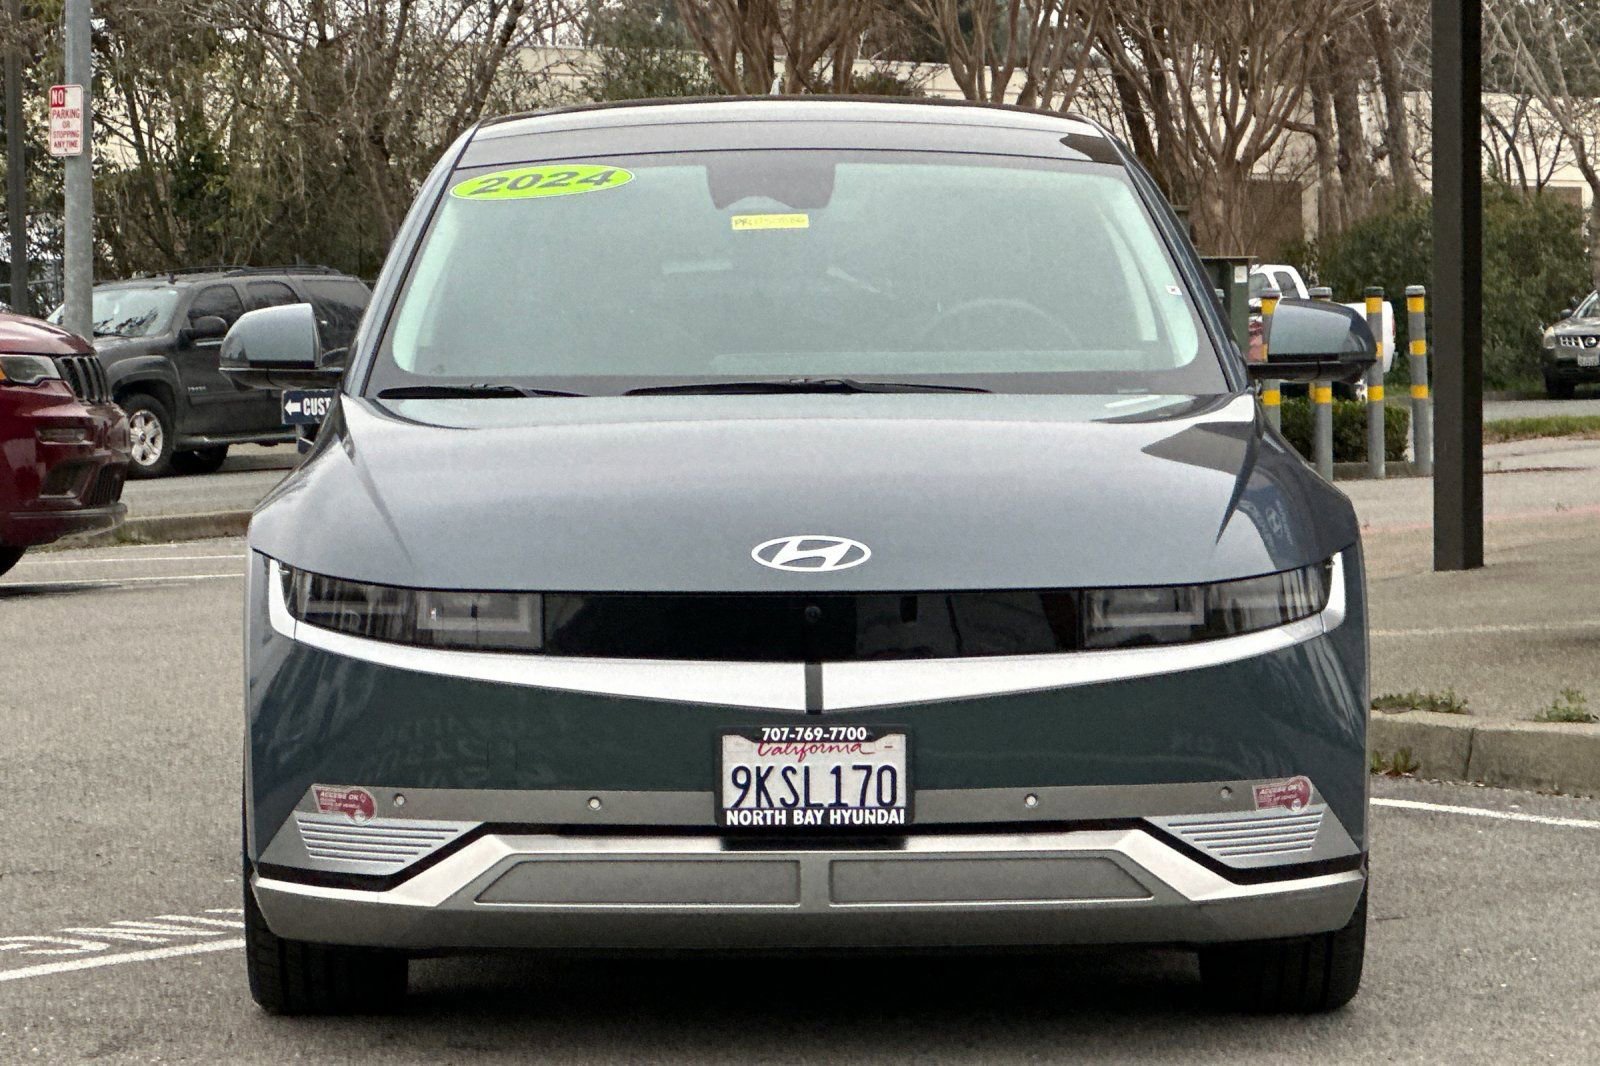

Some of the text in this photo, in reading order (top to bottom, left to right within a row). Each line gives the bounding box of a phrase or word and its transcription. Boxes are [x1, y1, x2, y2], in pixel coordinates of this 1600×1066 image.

[51, 89, 64, 105] NO
[52, 108, 80, 118] PARKING
[62, 120, 71, 128] OR
[53, 130, 80, 138] STOPPING
[468, 169, 617, 196] 2024
[761, 726, 867, 741] 707-769-7700
[757, 740, 875, 762] California
[731, 765, 897, 808] 9KSL170
[726, 809, 905, 826] NORTH BAY HYUNDAI
